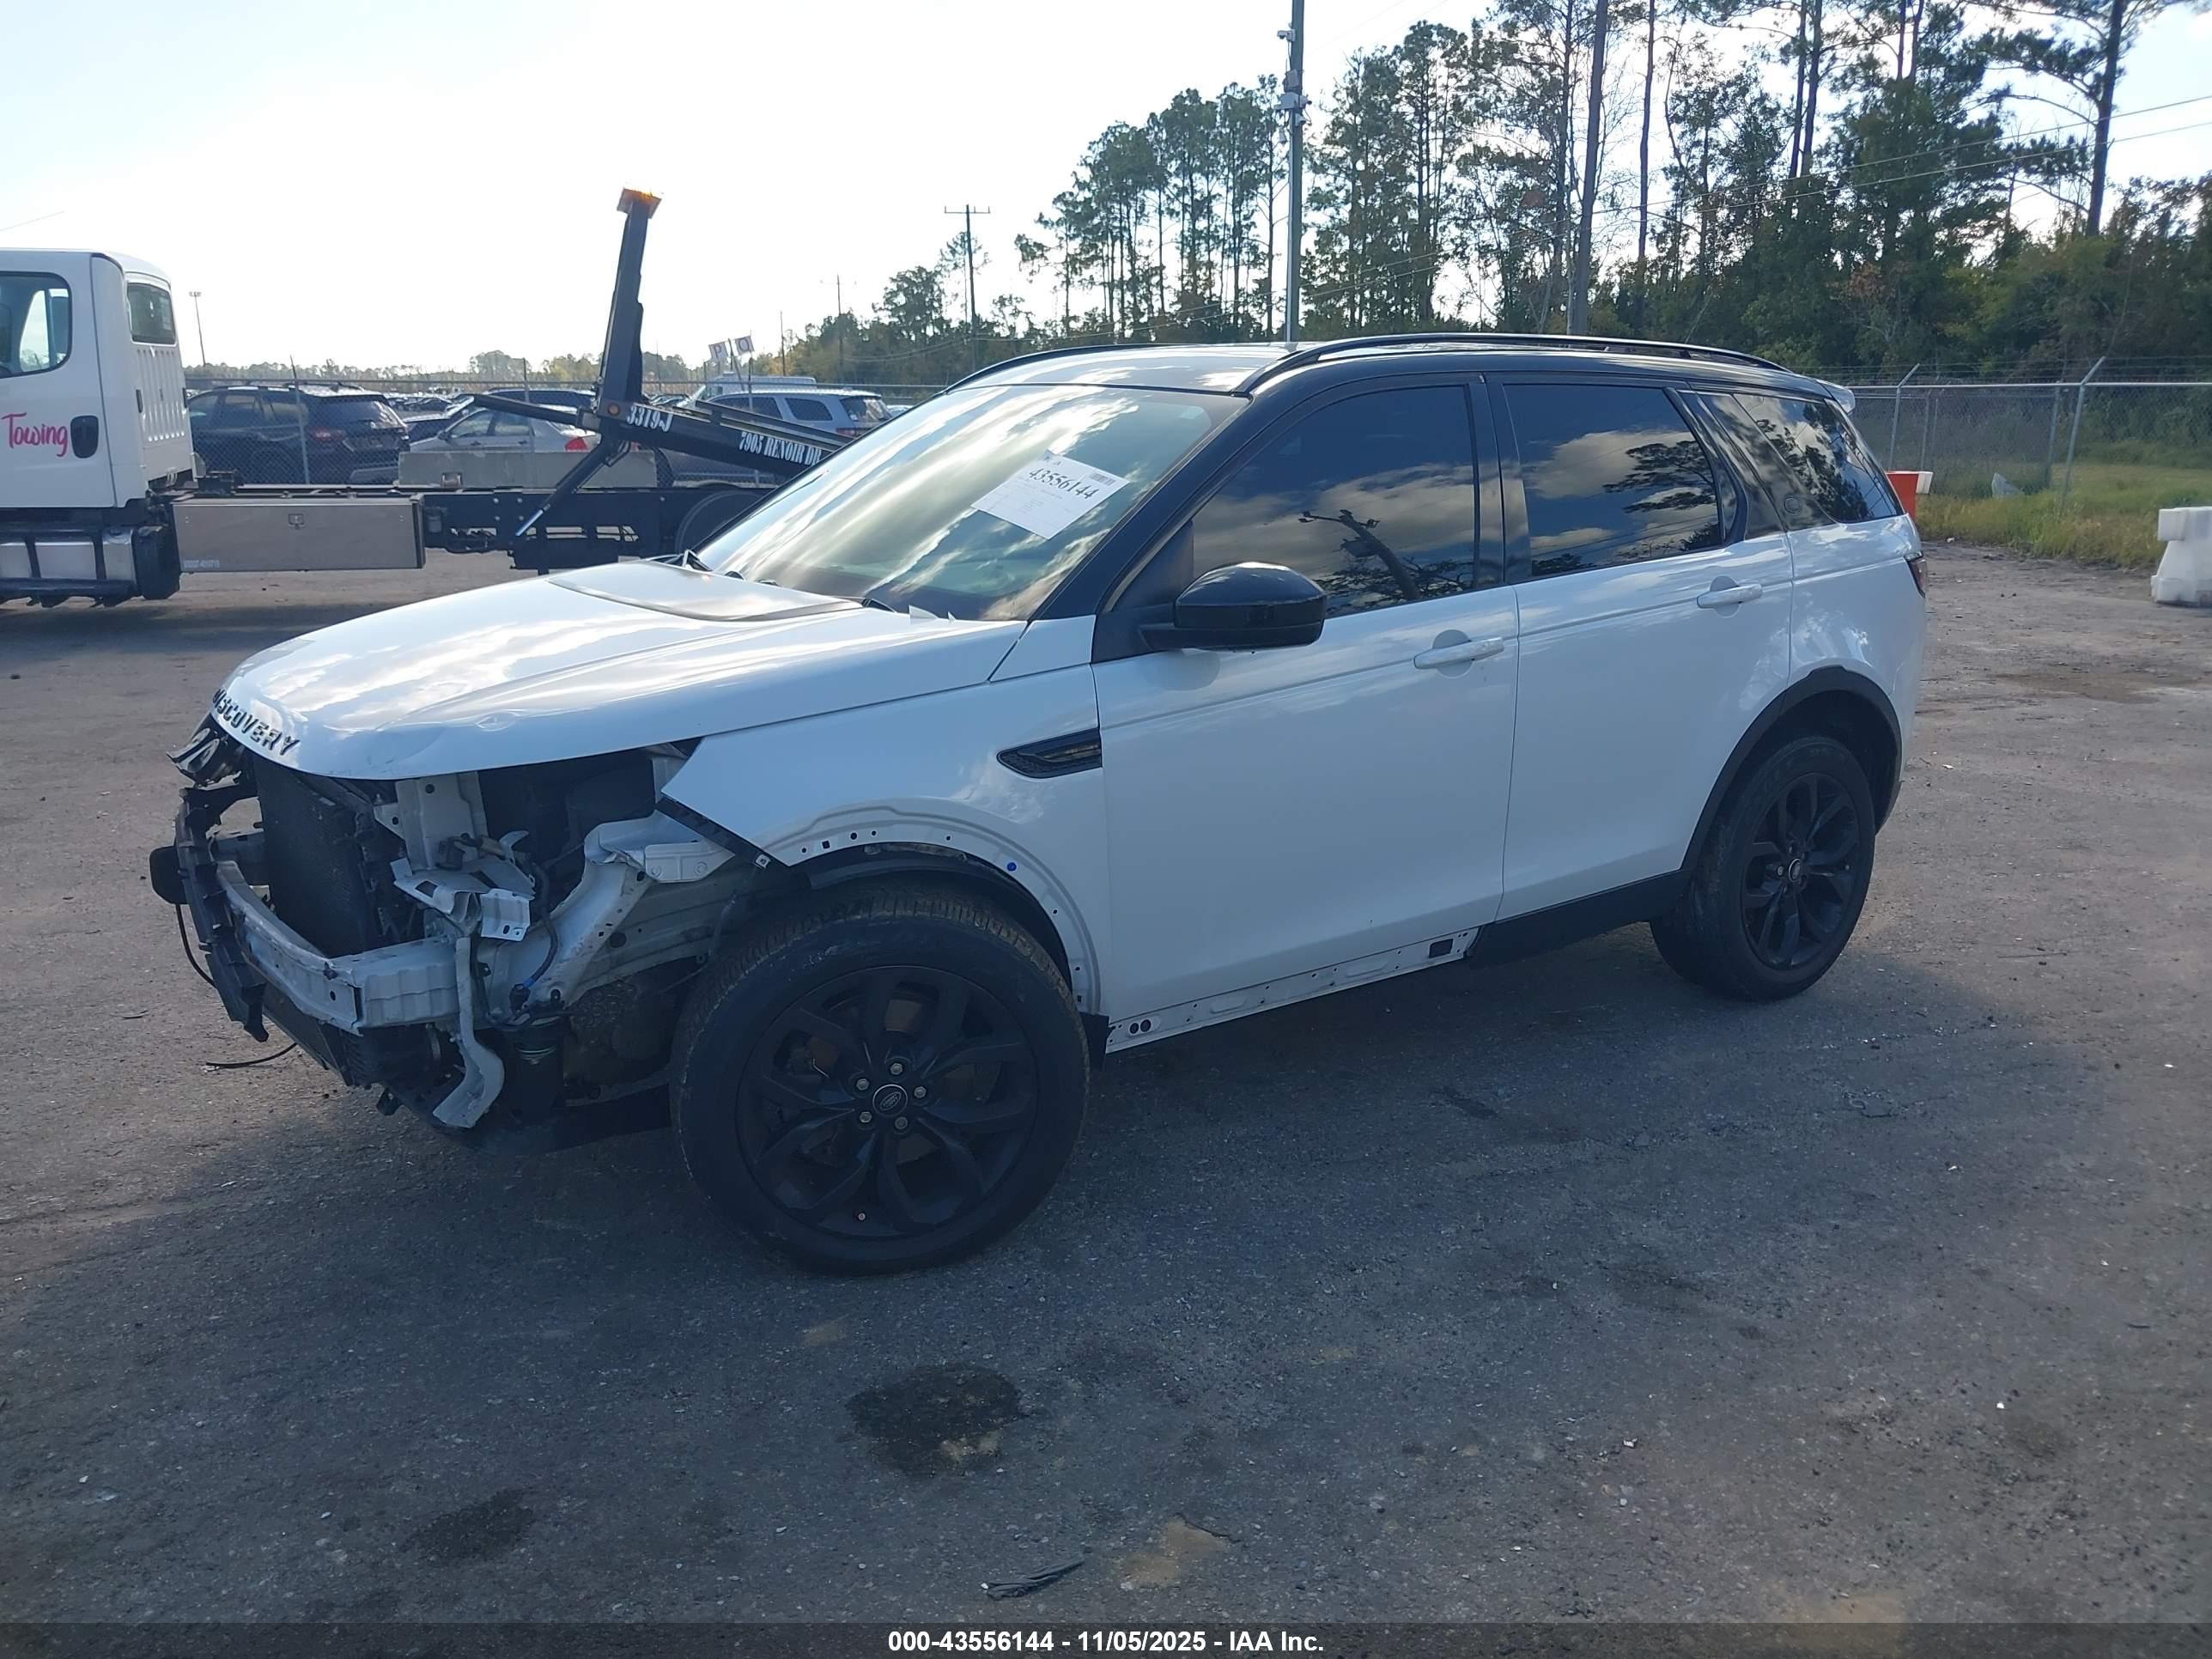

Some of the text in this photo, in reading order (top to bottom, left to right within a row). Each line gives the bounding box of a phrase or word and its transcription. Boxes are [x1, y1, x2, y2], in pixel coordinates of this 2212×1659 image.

[1, 411, 69, 458] Towing
[738, 431, 823, 466] 7905 RENOIR DR
[1029, 468, 1100, 500] 43556144
